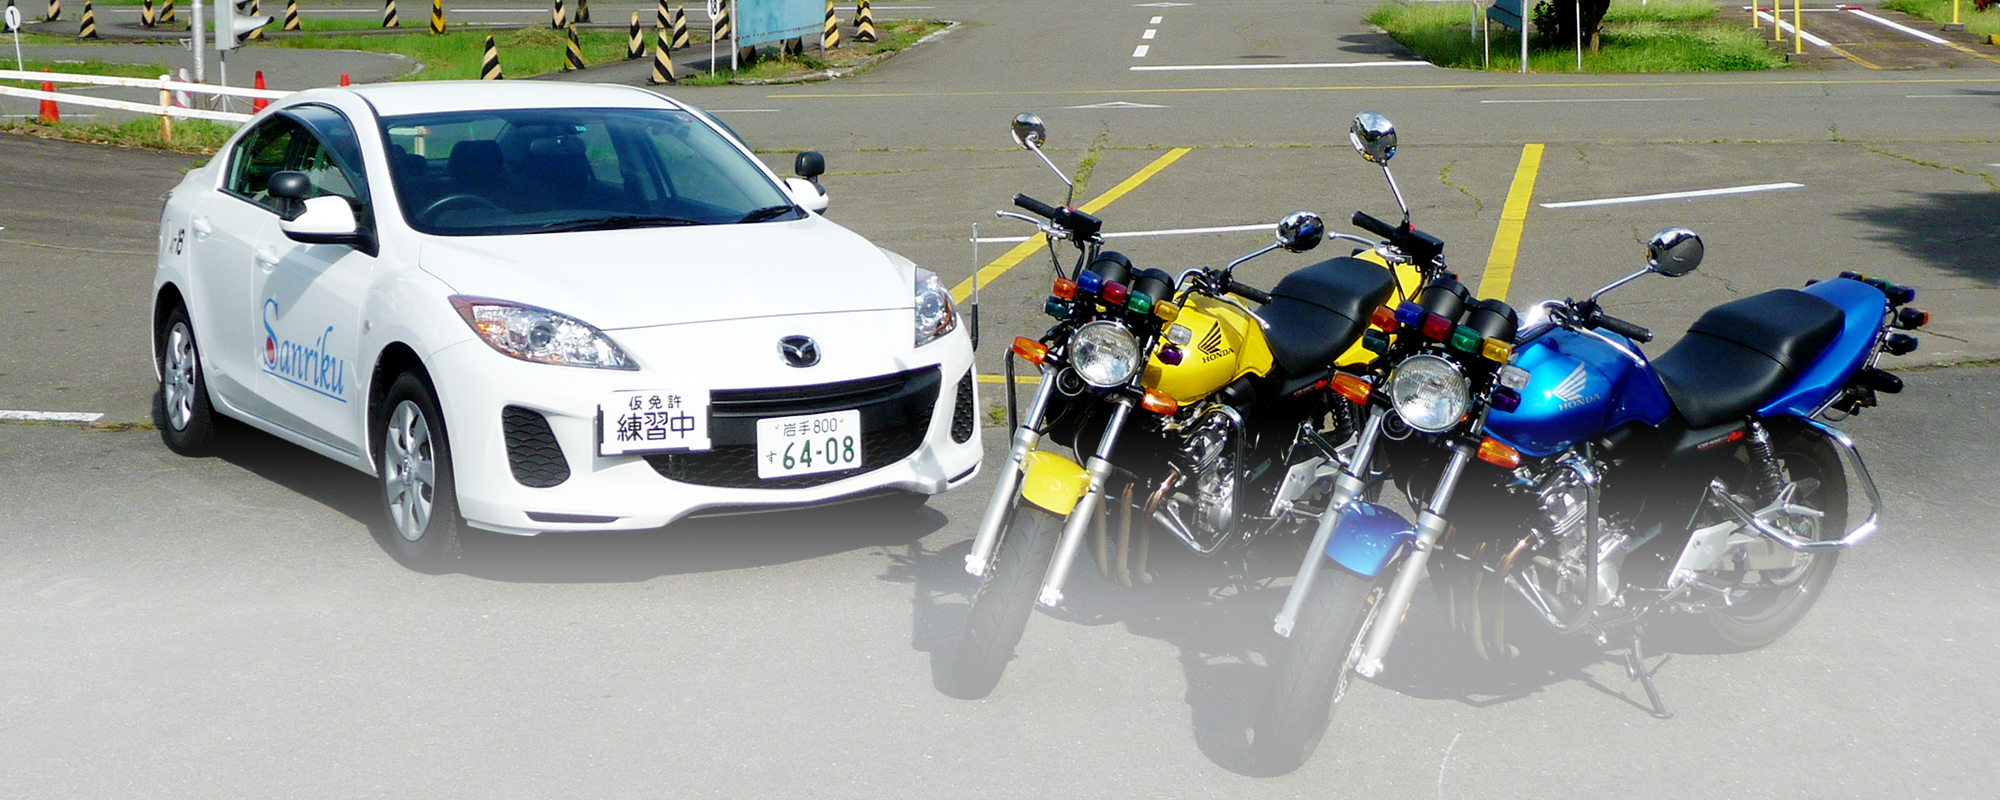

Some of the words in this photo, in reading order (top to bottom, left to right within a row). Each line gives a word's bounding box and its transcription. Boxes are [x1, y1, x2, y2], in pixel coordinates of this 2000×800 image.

[10, 10, 16, 26] 1
[262, 298, 344, 395] Sanriku
[1201, 347, 1235, 364] HONDA
[628, 394, 682, 411] 仮免許
[1558, 393, 1601, 411] HONDA
[616, 410, 695, 442] 練習中
[765, 450, 778, 465] す
[782, 435, 855, 470] 64-08
